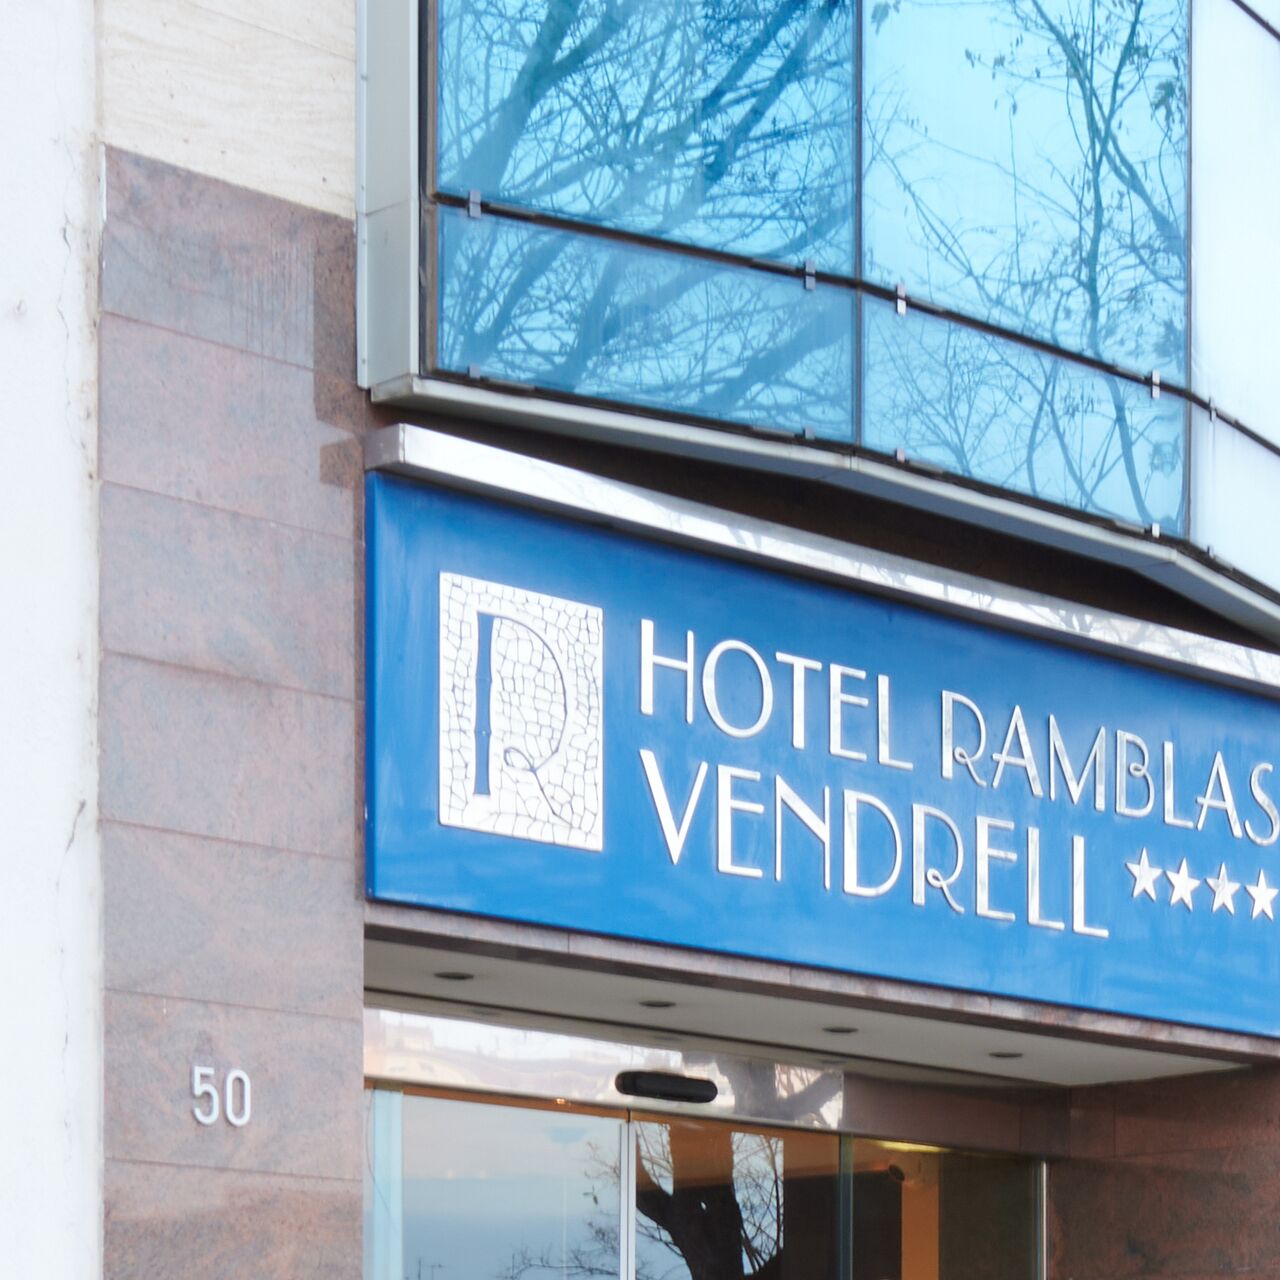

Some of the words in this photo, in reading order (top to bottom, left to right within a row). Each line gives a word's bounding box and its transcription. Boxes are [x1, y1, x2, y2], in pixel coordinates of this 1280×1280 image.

[639, 618, 914, 772] HOTEL
[639, 747, 1110, 939] VENDRELL
[192, 1065, 252, 1127] 50
